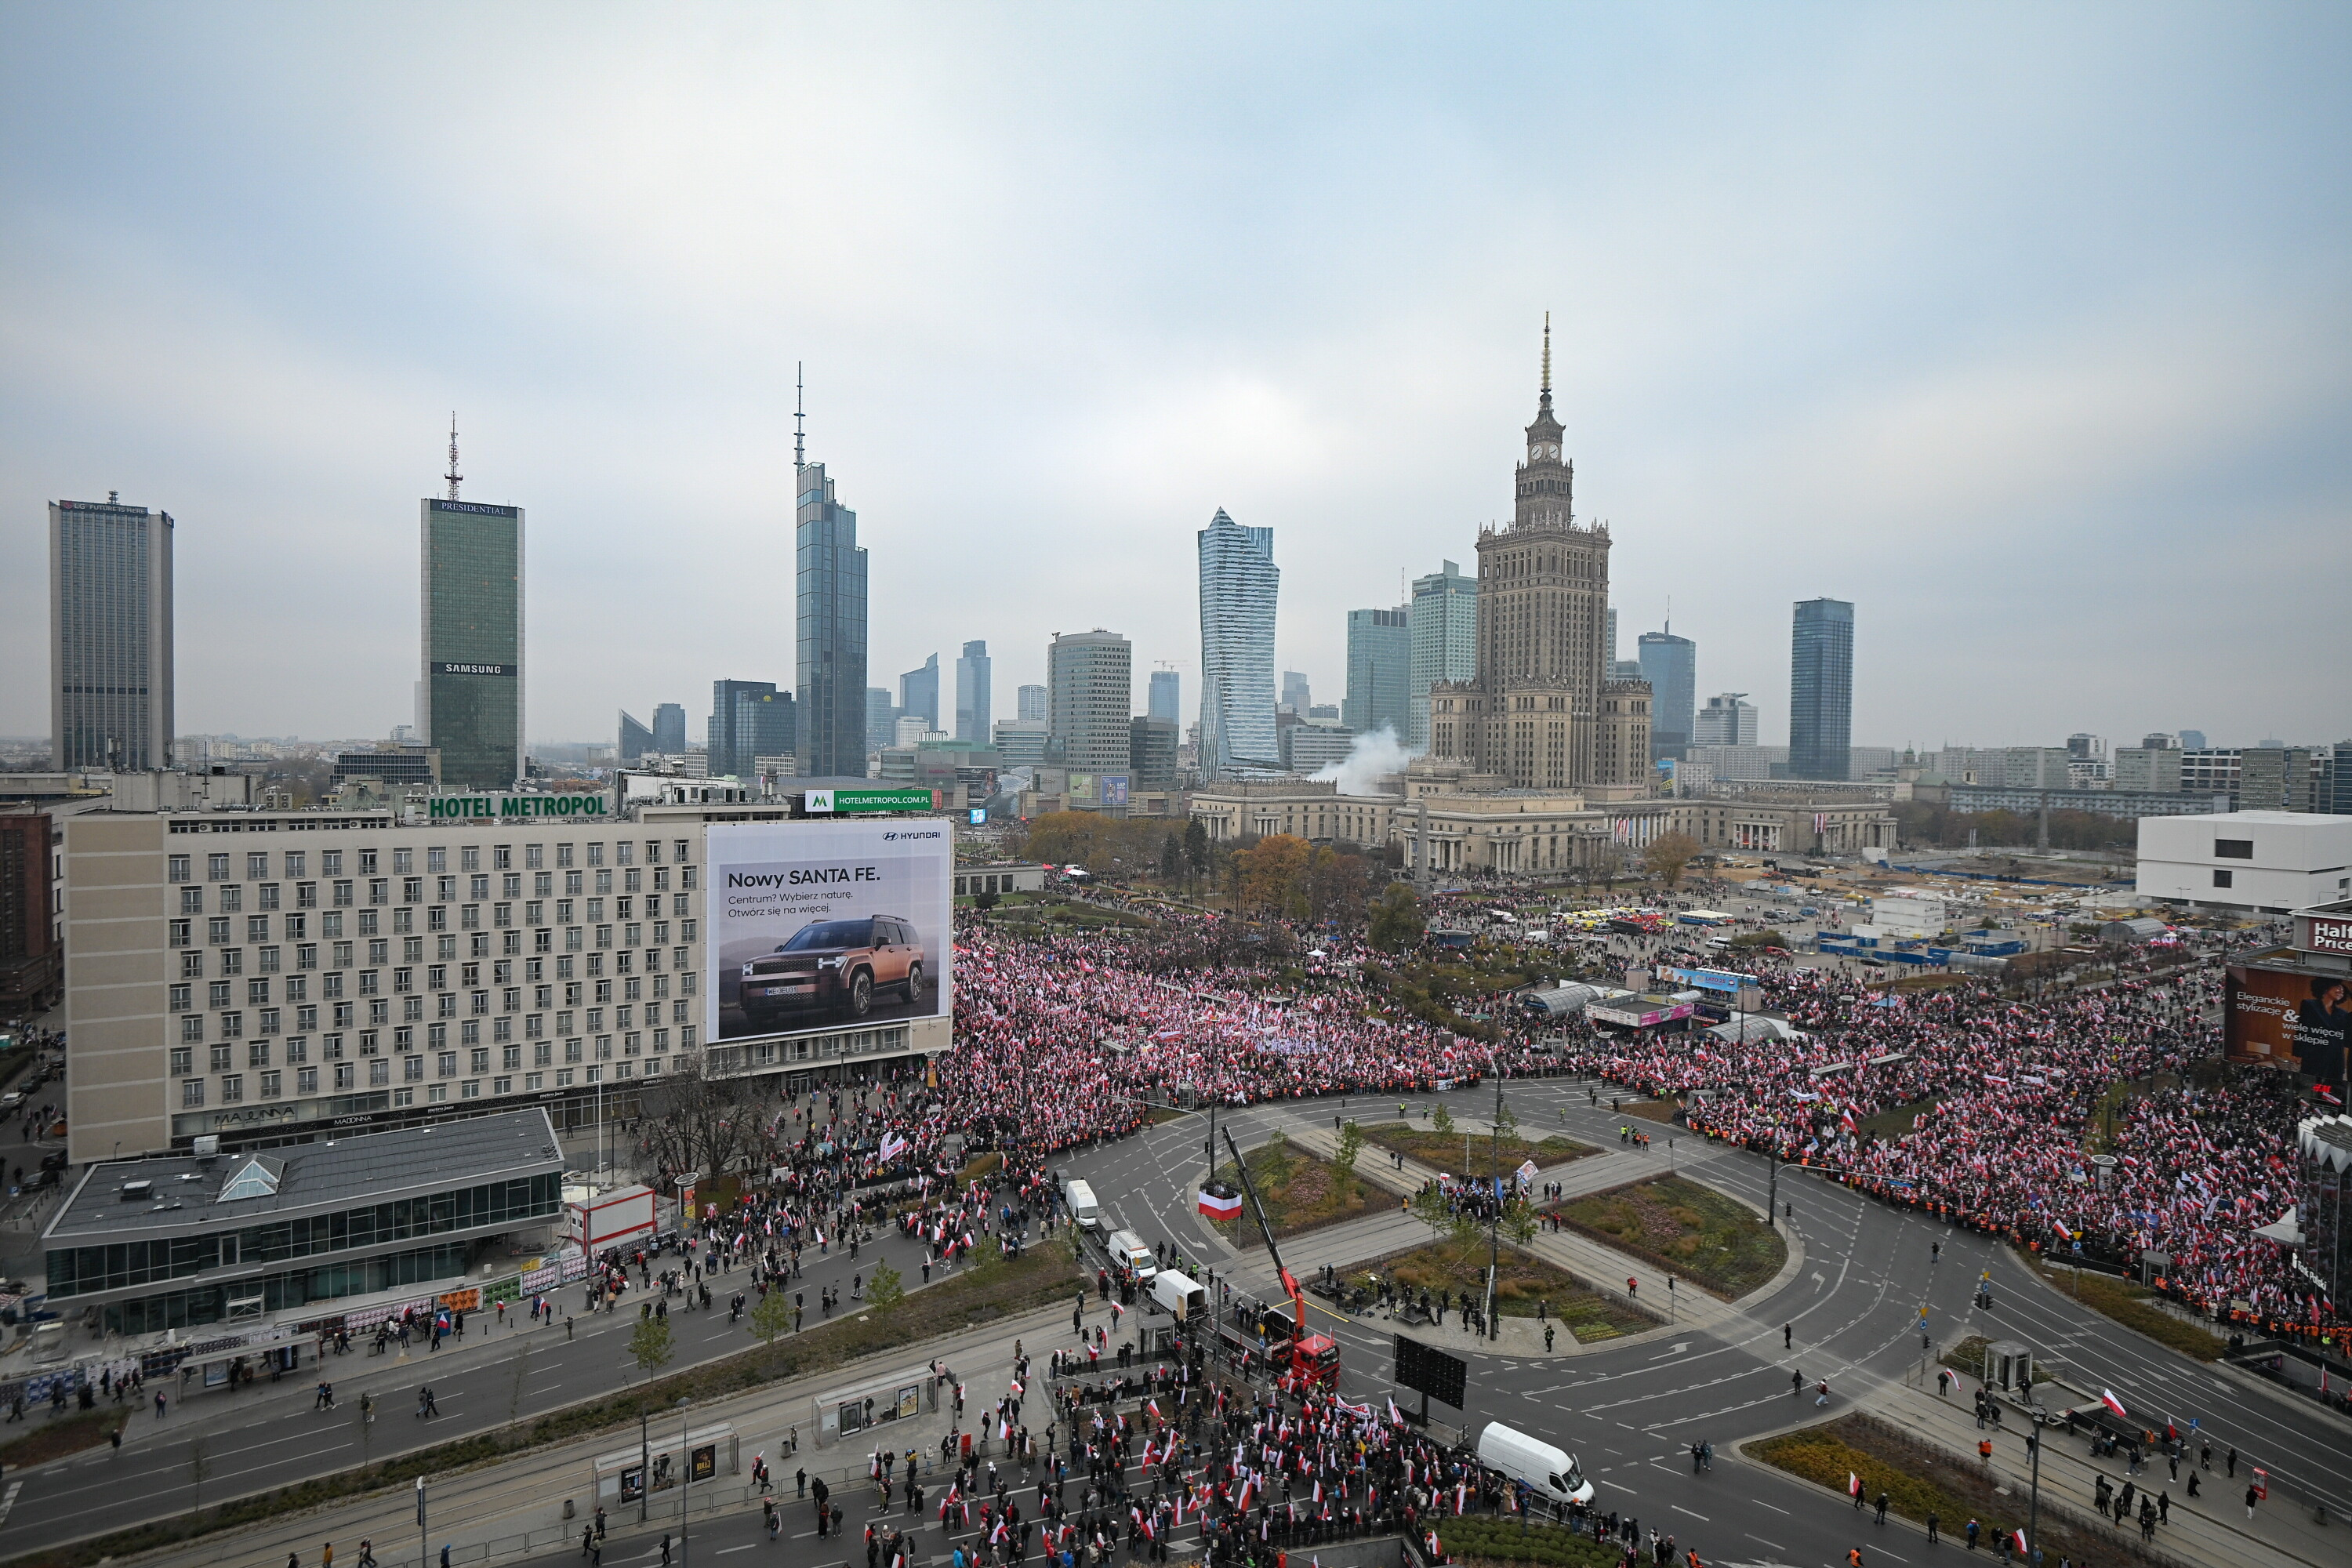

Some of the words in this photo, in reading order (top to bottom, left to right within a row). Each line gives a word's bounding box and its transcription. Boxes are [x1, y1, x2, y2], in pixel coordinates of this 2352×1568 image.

[441, 502, 506, 515] PRESIDENTIAL
[445, 663, 501, 674] SAMSUNG
[430, 797, 495, 818] HOTEL
[501, 796, 608, 817] METROPOL
[839, 796, 929, 804] HOTELMETROPOL.COM.PL
[900, 831, 941, 840] HYUNDAI
[728, 873, 785, 889] Nowy
[789, 868, 851, 885] SANTA
[855, 866, 880, 882] FE.
[728, 893, 777, 905] Centrum?
[779, 891, 818, 903] Wybierz
[821, 891, 853, 900] naturę.
[728, 907, 765, 918] Otwórz
[768, 906, 781, 917] się
[798, 904, 831, 914] więcej.
[2314, 935, 2352, 950] Price
[2236, 991, 2291, 1007] Eleganckie
[2236, 1001, 2281, 1016] stylizacje
[2282, 1008, 2300, 1023] &
[2282, 1022, 2309, 1033] wiele
[2310, 1027, 2345, 1040] więcej
[2293, 1033, 2329, 1047] sklepie
[334, 1115, 372, 1126] MADONNA
[2310, 1271, 2327, 1291] Polski
